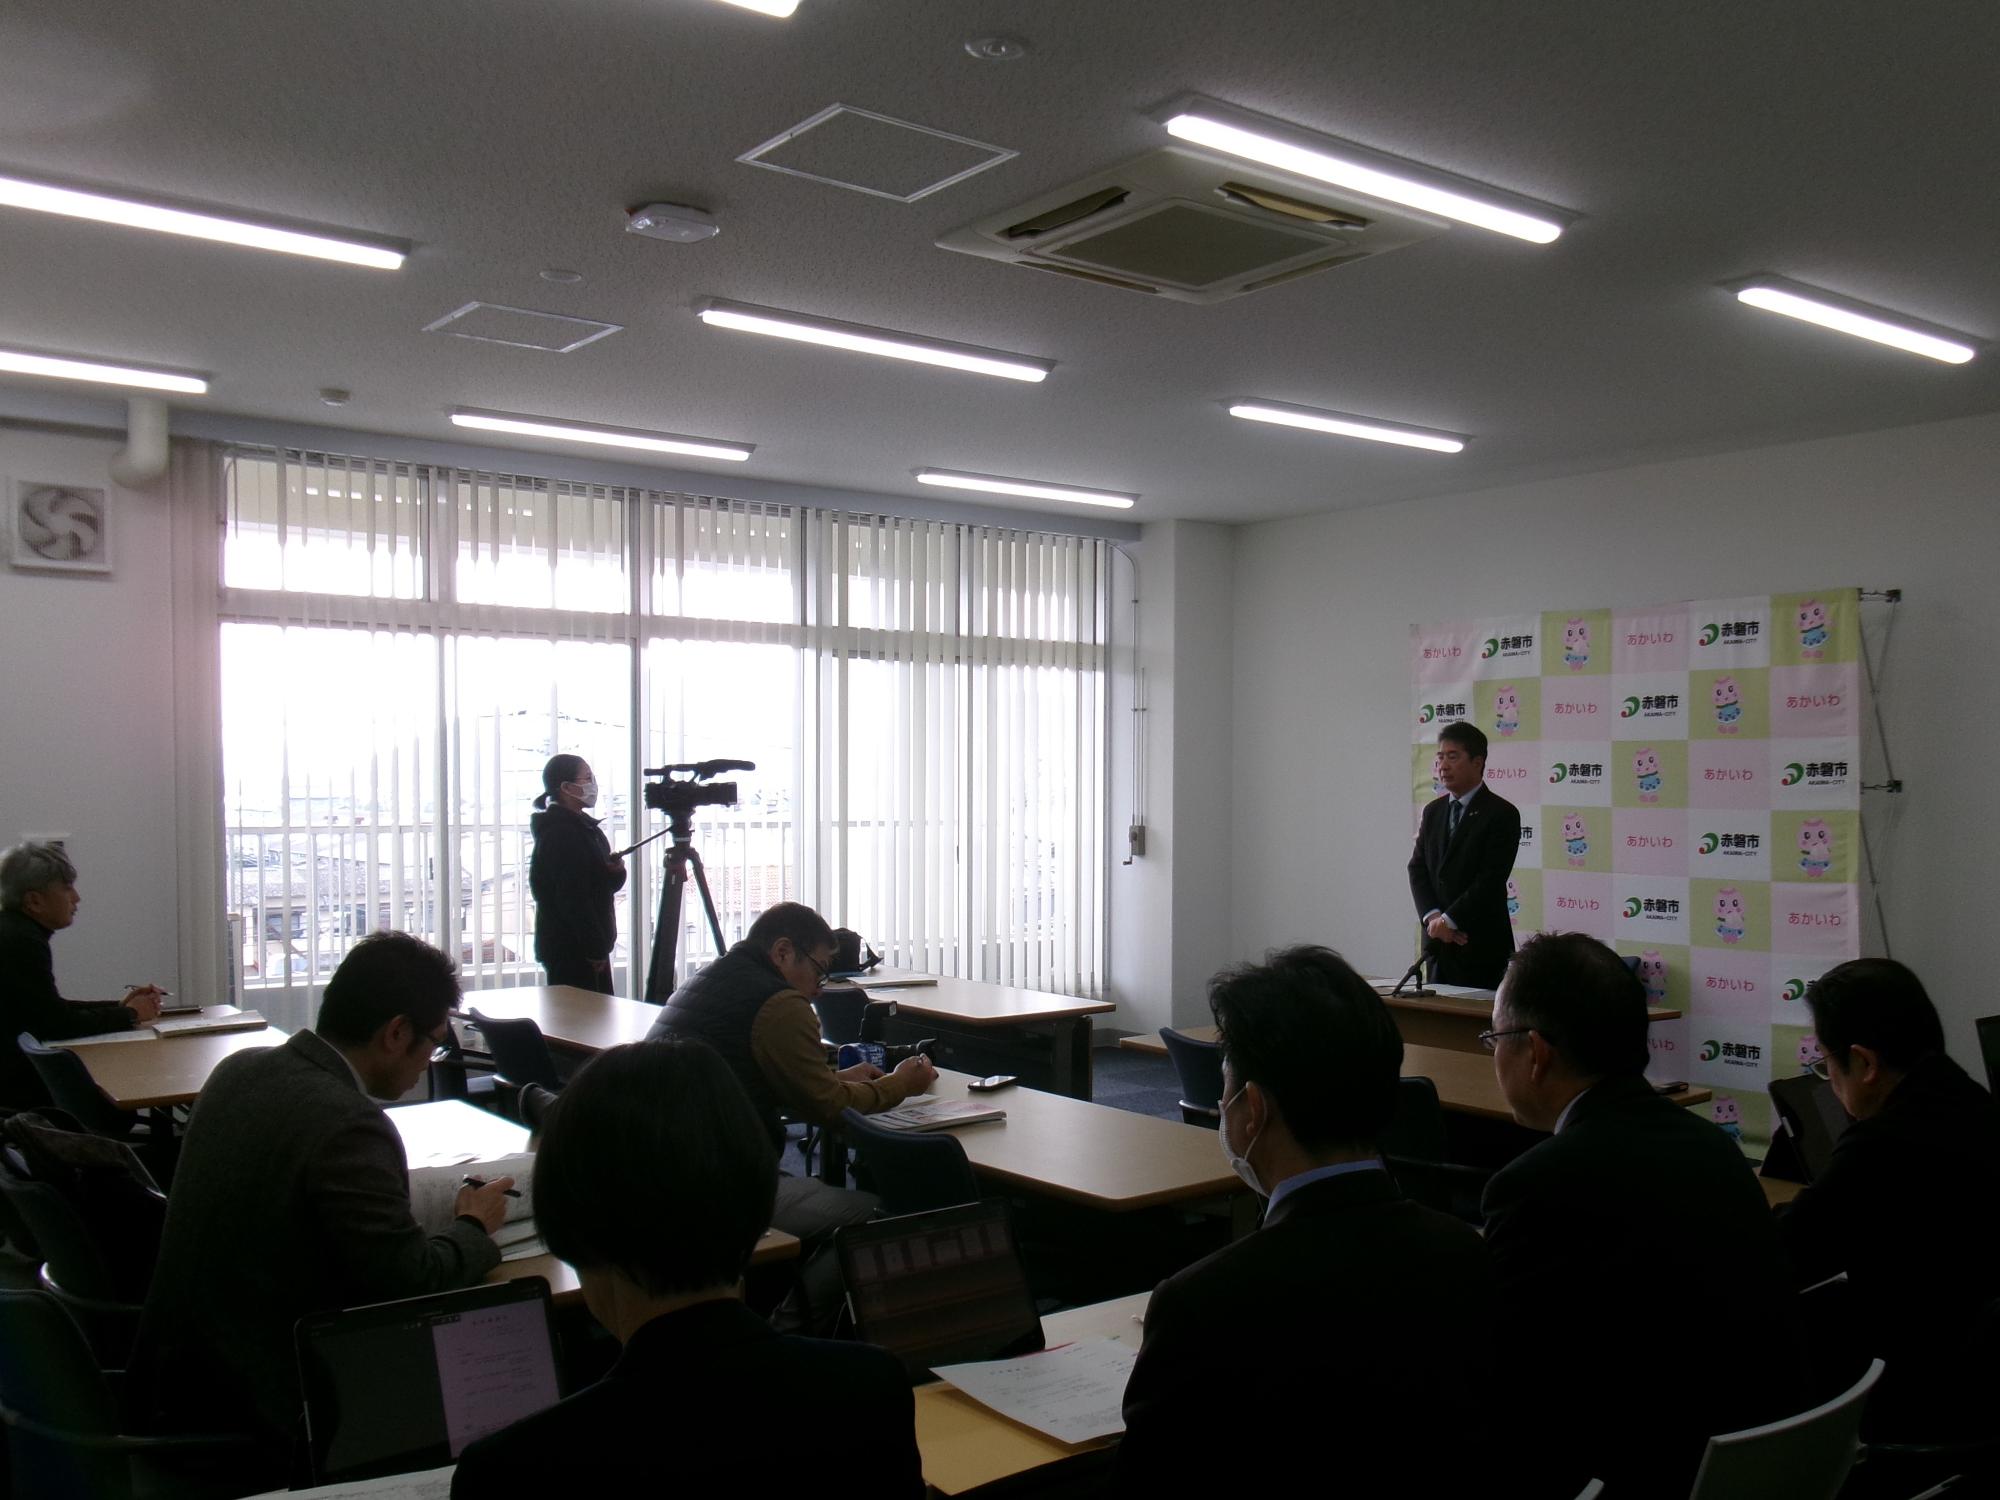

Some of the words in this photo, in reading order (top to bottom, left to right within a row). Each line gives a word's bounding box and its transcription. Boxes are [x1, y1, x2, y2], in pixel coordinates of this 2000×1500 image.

[1721, 621, 1759, 637] 赤磐市
[1501, 636, 1532, 650] 赤磐市
[1627, 633, 1673, 645] あかいわ
[1424, 648, 1462, 657] あかいわ
[1642, 695, 1678, 709] 赤磐市
[1787, 694, 1841, 708] あかいわ
[1436, 704, 1465, 716] 赤磐市
[1555, 703, 1597, 714] あかいわ
[1488, 768, 1527, 779] あかいわ
[1569, 764, 1603, 776] 赤磐市
[1705, 769, 1753, 780] あかいわ
[1806, 762, 1847, 777] 赤磐市
[1626, 836, 1673, 847] あかいわ
[1721, 834, 1760, 849] 赤磐市
[1557, 897, 1600, 910] あかいわ
[1644, 899, 1680, 913] 赤磐市
[1788, 912, 1841, 926] あかいわ
[1706, 976, 1754, 991] あかいわ
[1722, 1042, 1761, 1060] 赤磐市
